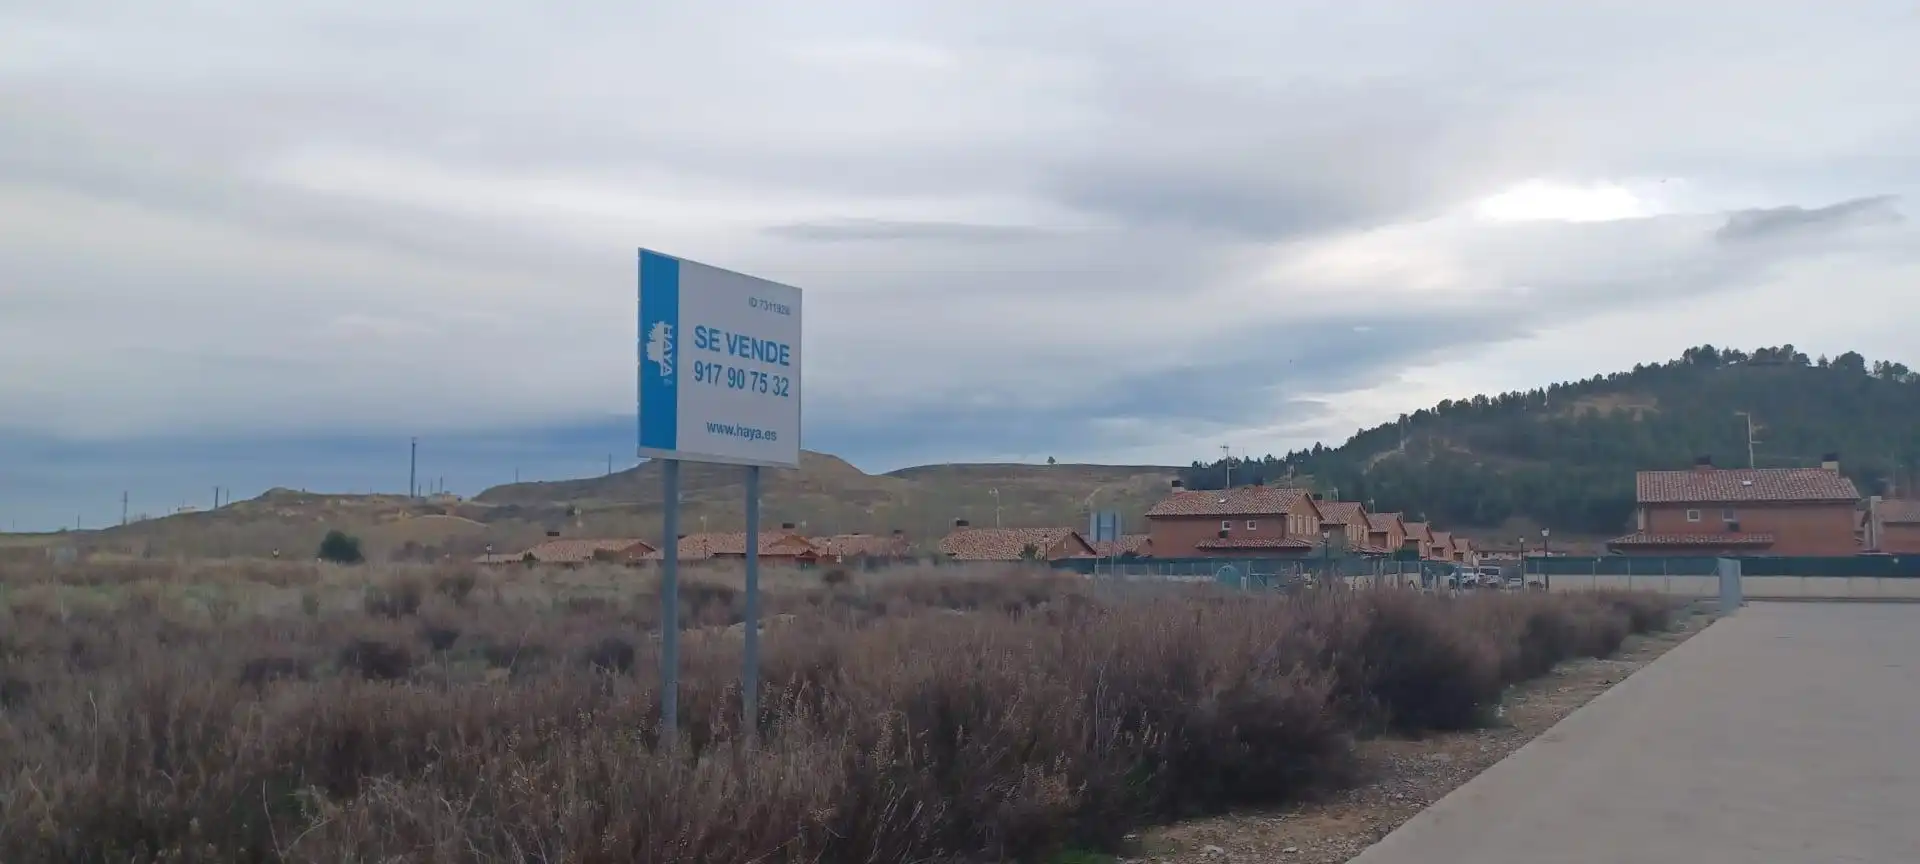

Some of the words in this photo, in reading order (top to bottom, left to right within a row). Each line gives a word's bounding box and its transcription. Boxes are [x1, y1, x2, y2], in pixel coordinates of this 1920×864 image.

[663, 324, 673, 376] HAYA
[694, 325, 721, 352] SE
[726, 332, 790, 366] VENDE
[694, 360, 722, 386] 917
[727, 367, 745, 390] 90
[750, 371, 767, 393] 75
[772, 375, 789, 397] 32
[706, 421, 777, 441] www.haya.es
